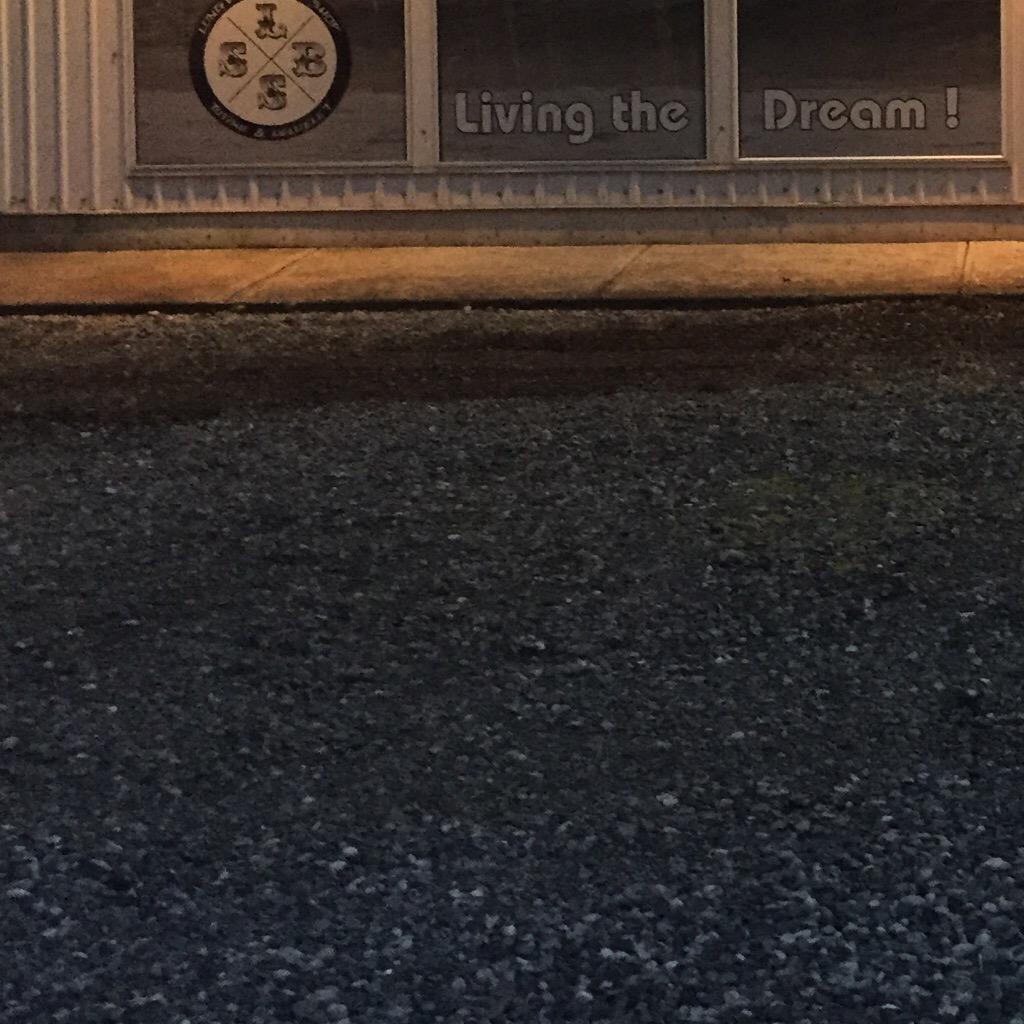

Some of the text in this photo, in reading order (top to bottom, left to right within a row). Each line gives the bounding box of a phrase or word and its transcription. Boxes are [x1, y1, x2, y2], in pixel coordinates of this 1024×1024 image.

[254, 2, 288, 39] L
[218, 41, 248, 78] S
[291, 41, 328, 78] B
[257, 74, 288, 111] S
[454, 89, 595, 144] Living
[611, 89, 690, 132] the
[763, 88, 927, 131] Dream
